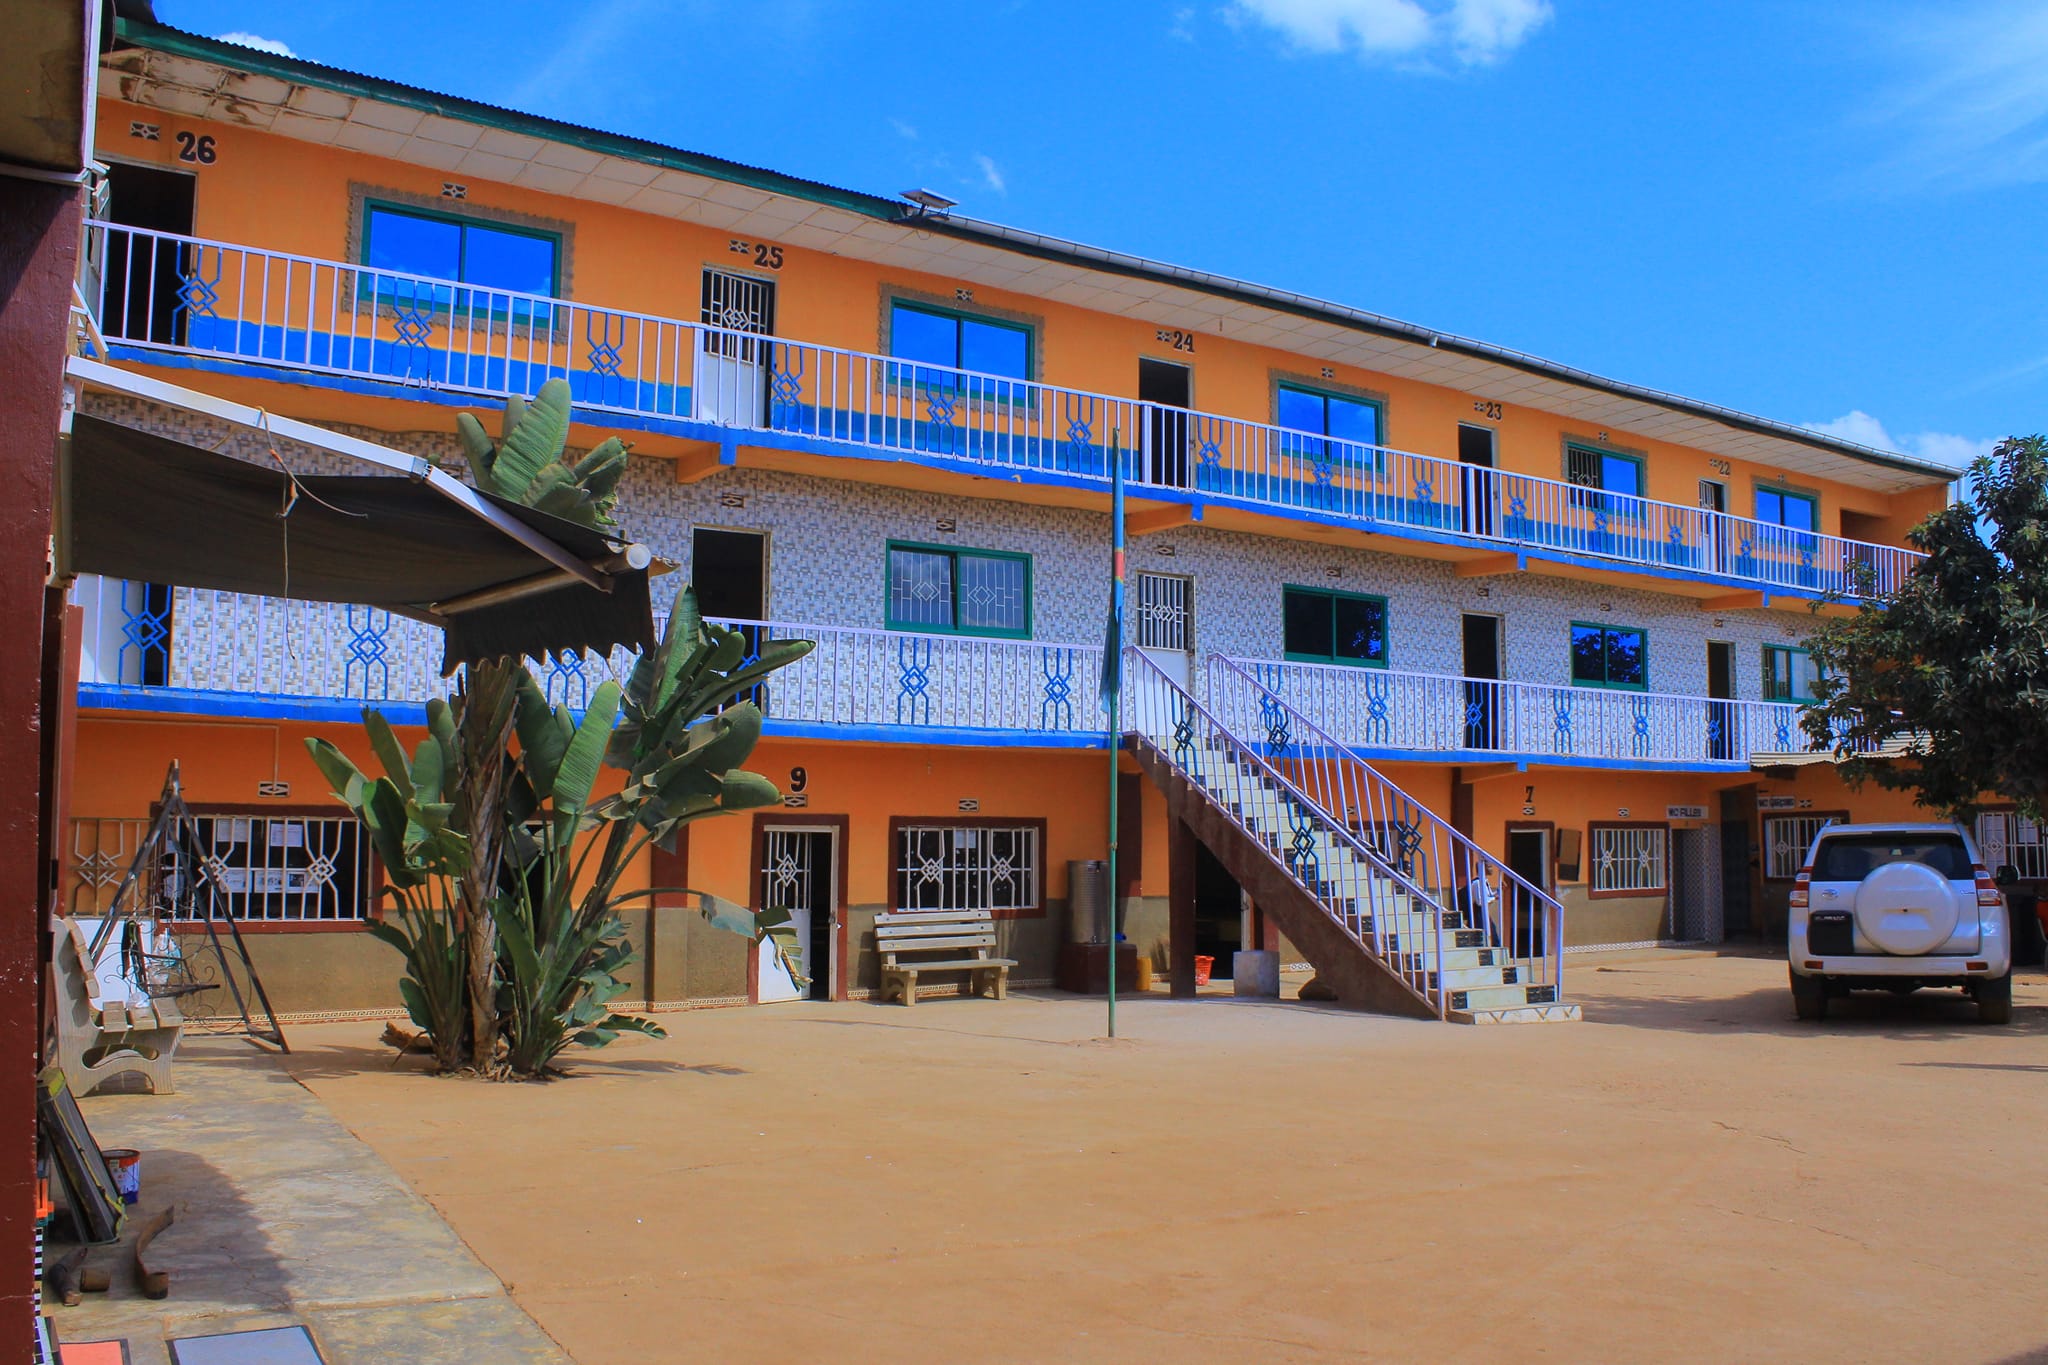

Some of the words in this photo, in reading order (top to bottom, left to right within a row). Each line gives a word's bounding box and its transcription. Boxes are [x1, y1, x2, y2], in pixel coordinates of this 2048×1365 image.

[176, 131, 217, 165] 26
[754, 243, 784, 270] 25
[1173, 330, 1195, 353] 24
[1486, 401, 1502, 420] 23
[1719, 460, 1731, 475] 22
[790, 767, 807, 792] 9
[1525, 785, 1535, 803] 7
